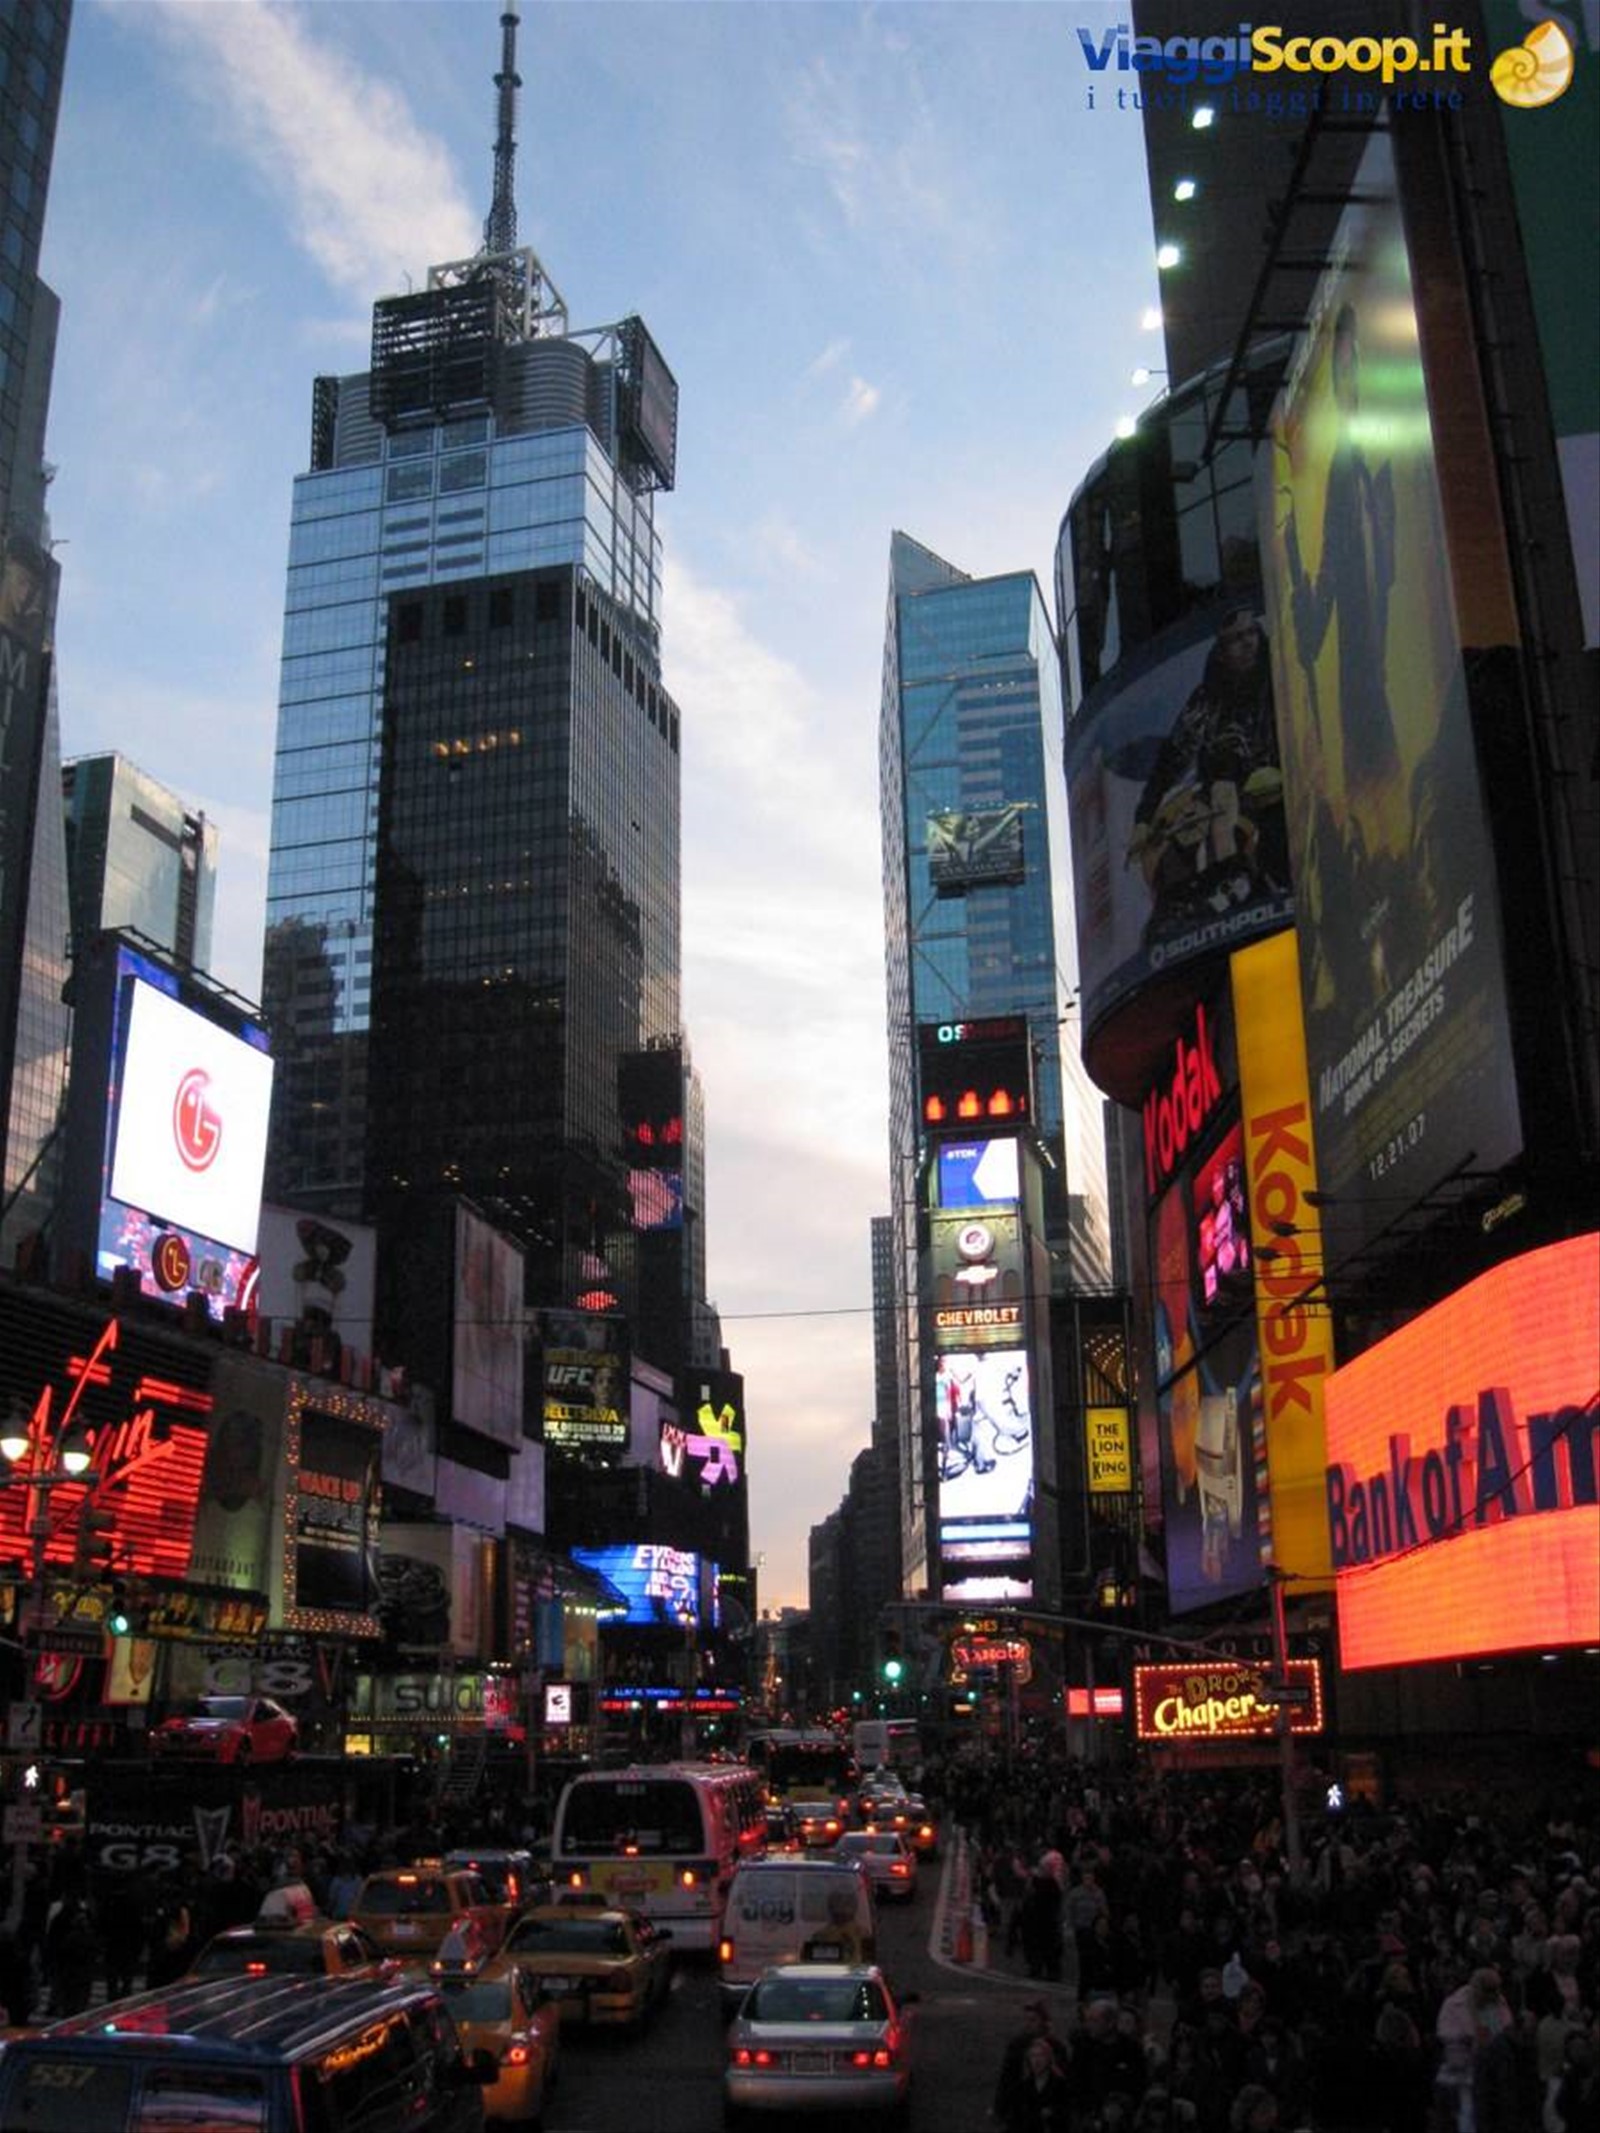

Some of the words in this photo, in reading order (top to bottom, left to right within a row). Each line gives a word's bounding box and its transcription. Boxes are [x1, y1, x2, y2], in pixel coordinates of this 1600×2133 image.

[1384, 893, 1475, 1036] TREASURE
[1143, 1001, 1222, 1195] Kodak
[1369, 1113, 1427, 1182] 12.21.07
[1249, 1101, 1327, 1420] Kodak
[936, 1308, 1019, 1327] CHEVROLET
[547, 1365, 594, 1387] UFC
[1095, 1423, 1120, 1436] THE
[1092, 1440, 1124, 1458] LION
[1093, 1461, 1127, 1480] KING
[1326, 1432, 1418, 1570] Bank
[1421, 1403, 1475, 1540] of
[1184, 1669, 1264, 1705] DROWS
[1154, 1692, 1281, 1732] Chaper
[89, 1821, 197, 1838] PONTIAC
[100, 1842, 183, 1871] G8
